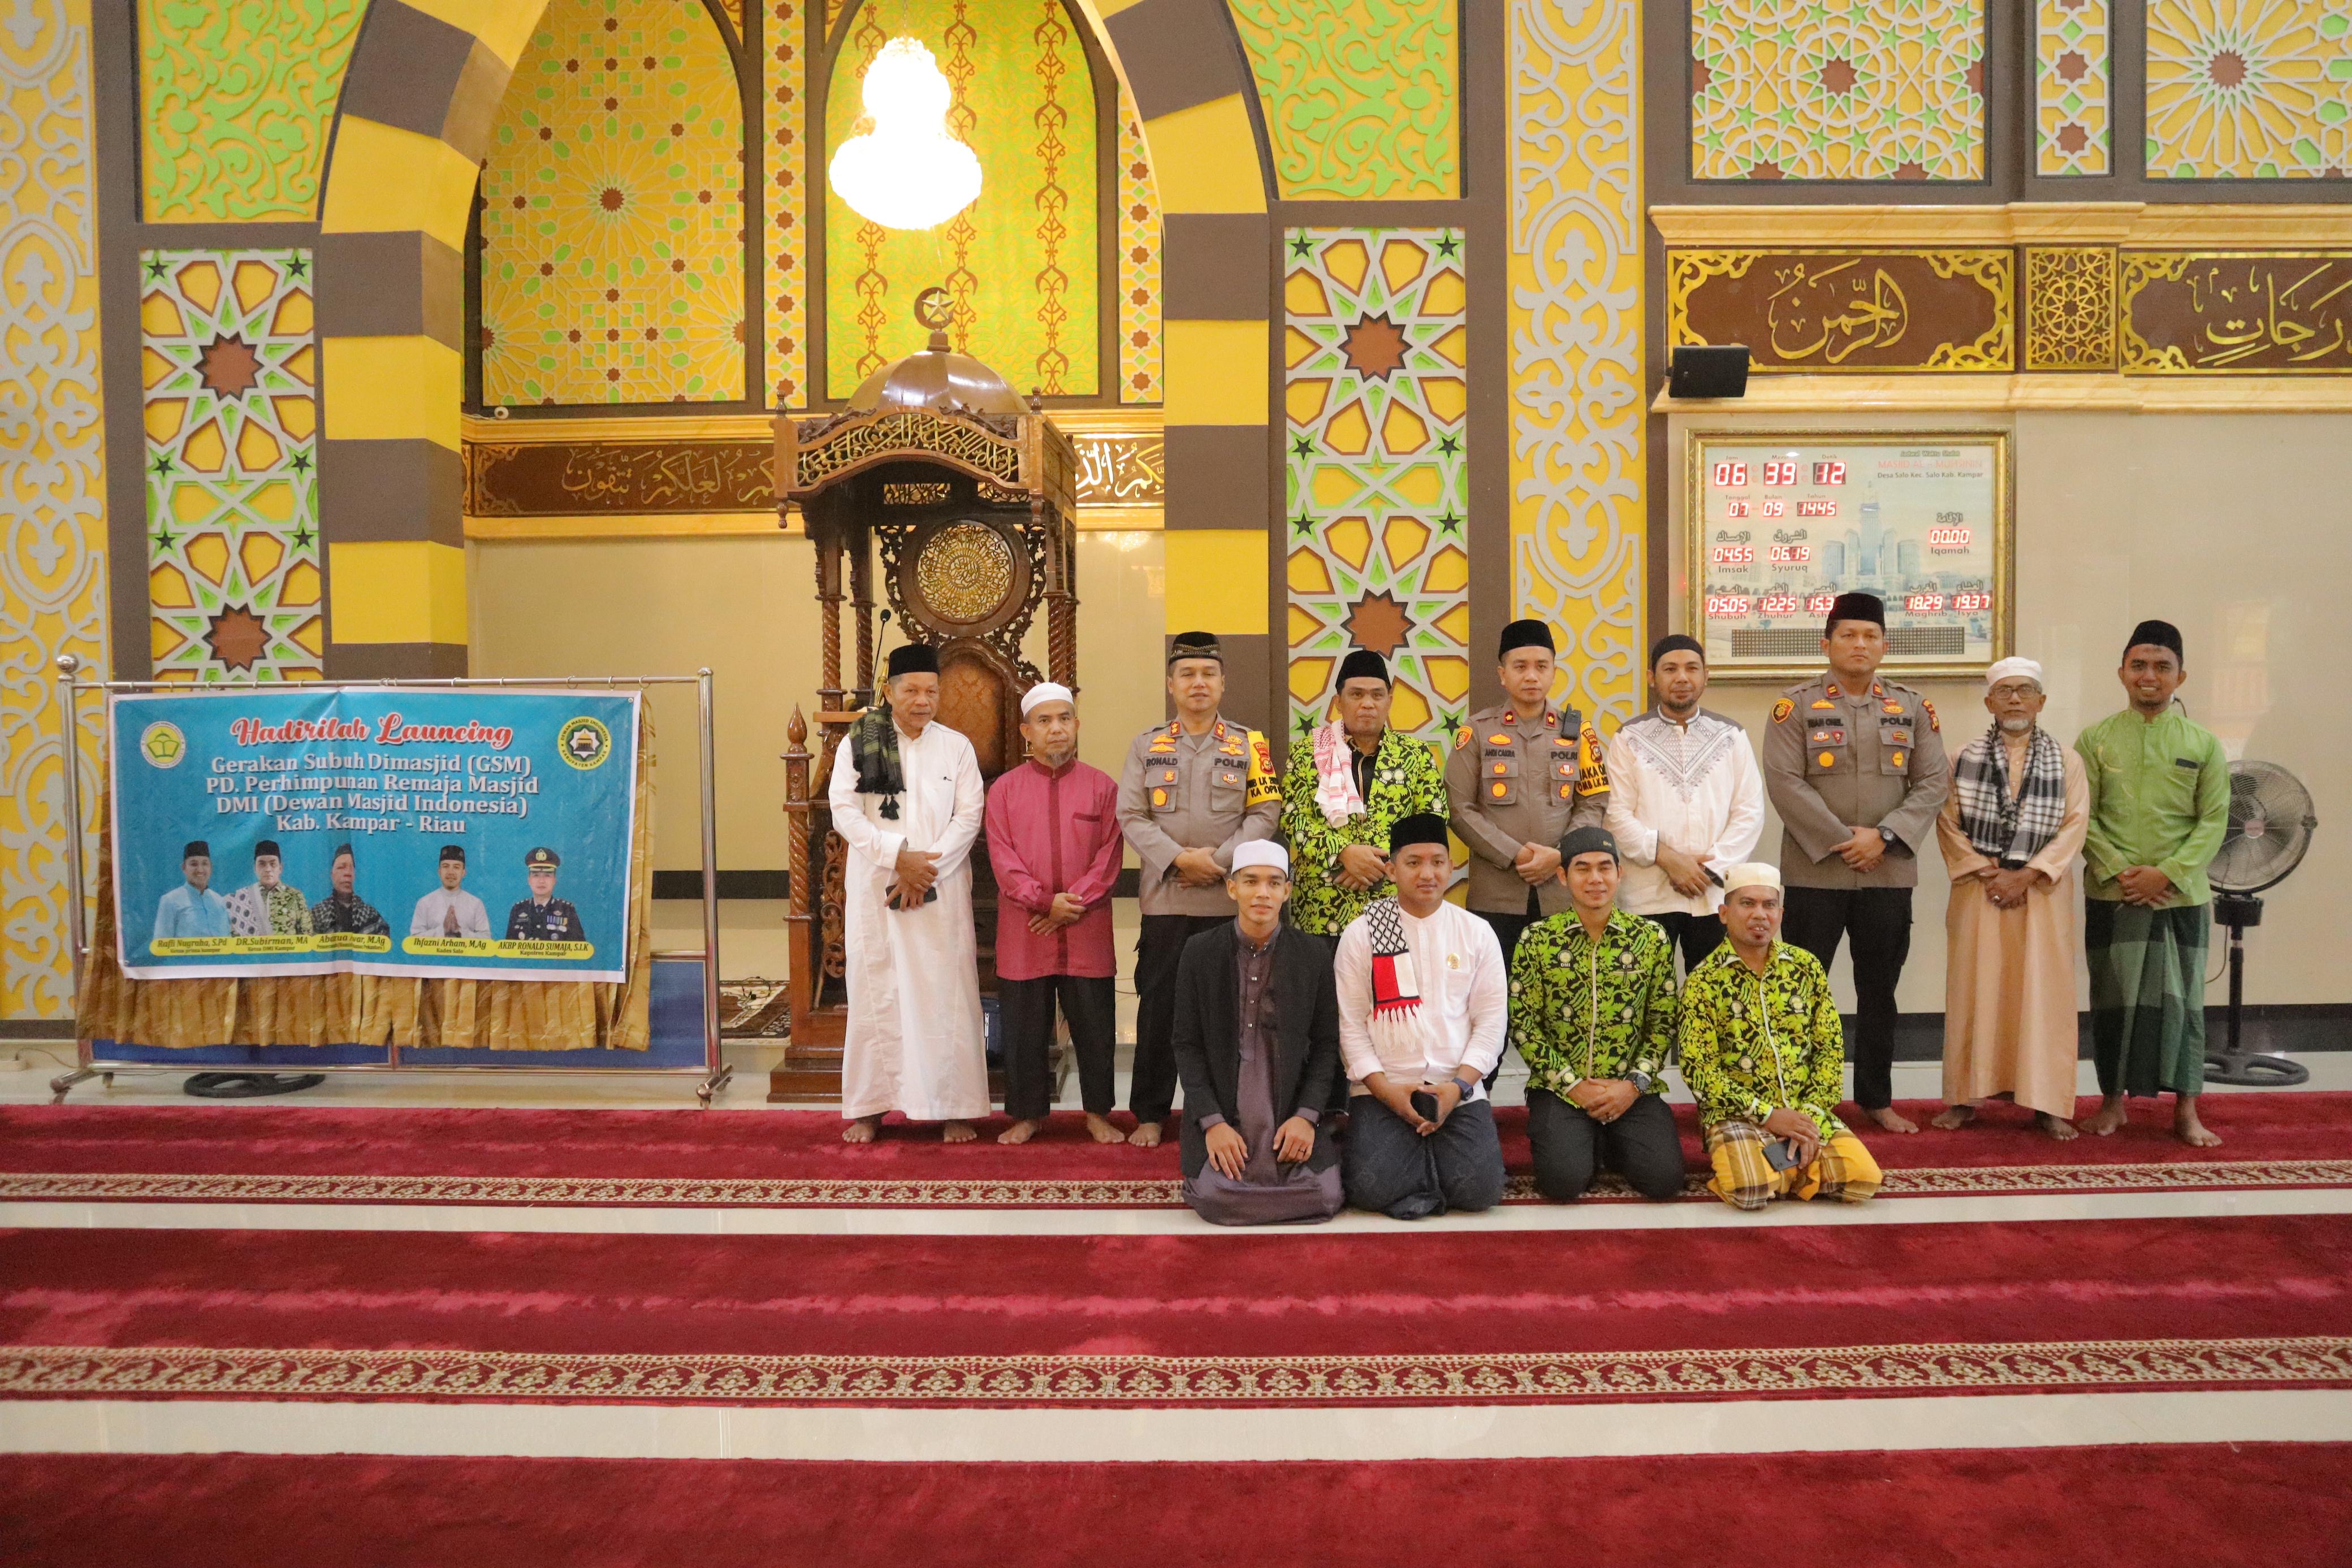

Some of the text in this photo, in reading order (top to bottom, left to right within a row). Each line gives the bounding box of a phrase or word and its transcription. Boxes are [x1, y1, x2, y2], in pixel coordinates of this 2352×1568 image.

[1715, 464, 1746, 486] 06
[1765, 462, 1796, 484] 39
[1820, 462, 1845, 484] 12
[1728, 503, 1749, 517] 07
[1763, 502, 1783, 517] 09
[1801, 501, 1836, 516] 1445
[1931, 546, 1969, 556] Iqamah
[1772, 564, 1808, 573] Syuruq
[1880, 718, 1912, 727] POLRI
[230, 712, 513, 751] Hadirilah Launcing
[1146, 757, 1178, 767] RONALD
[1551, 751, 1577, 760] POLRI
[211, 752, 531, 778] Gerakan Subuh Dimasjid (GSM)
[1214, 757, 1248, 770] POLRI
[206, 774, 539, 798] PD. Perhimpunan Remaja Masjid
[1251, 787, 1261, 798] KA
[217, 793, 528, 818] DMI (Dewan Masjid Indonesia)
[276, 813, 320, 831] Kab.
[326, 813, 400, 835] Kampar
[420, 816, 466, 833] Riau
[211, 938, 227, 946] S.Pd
[367, 936, 385, 946] M.Ag
[414, 938, 439, 947] Ihfazni
[440, 939, 467, 948] Arham,
[546, 943, 573, 952] SUMAJA,
